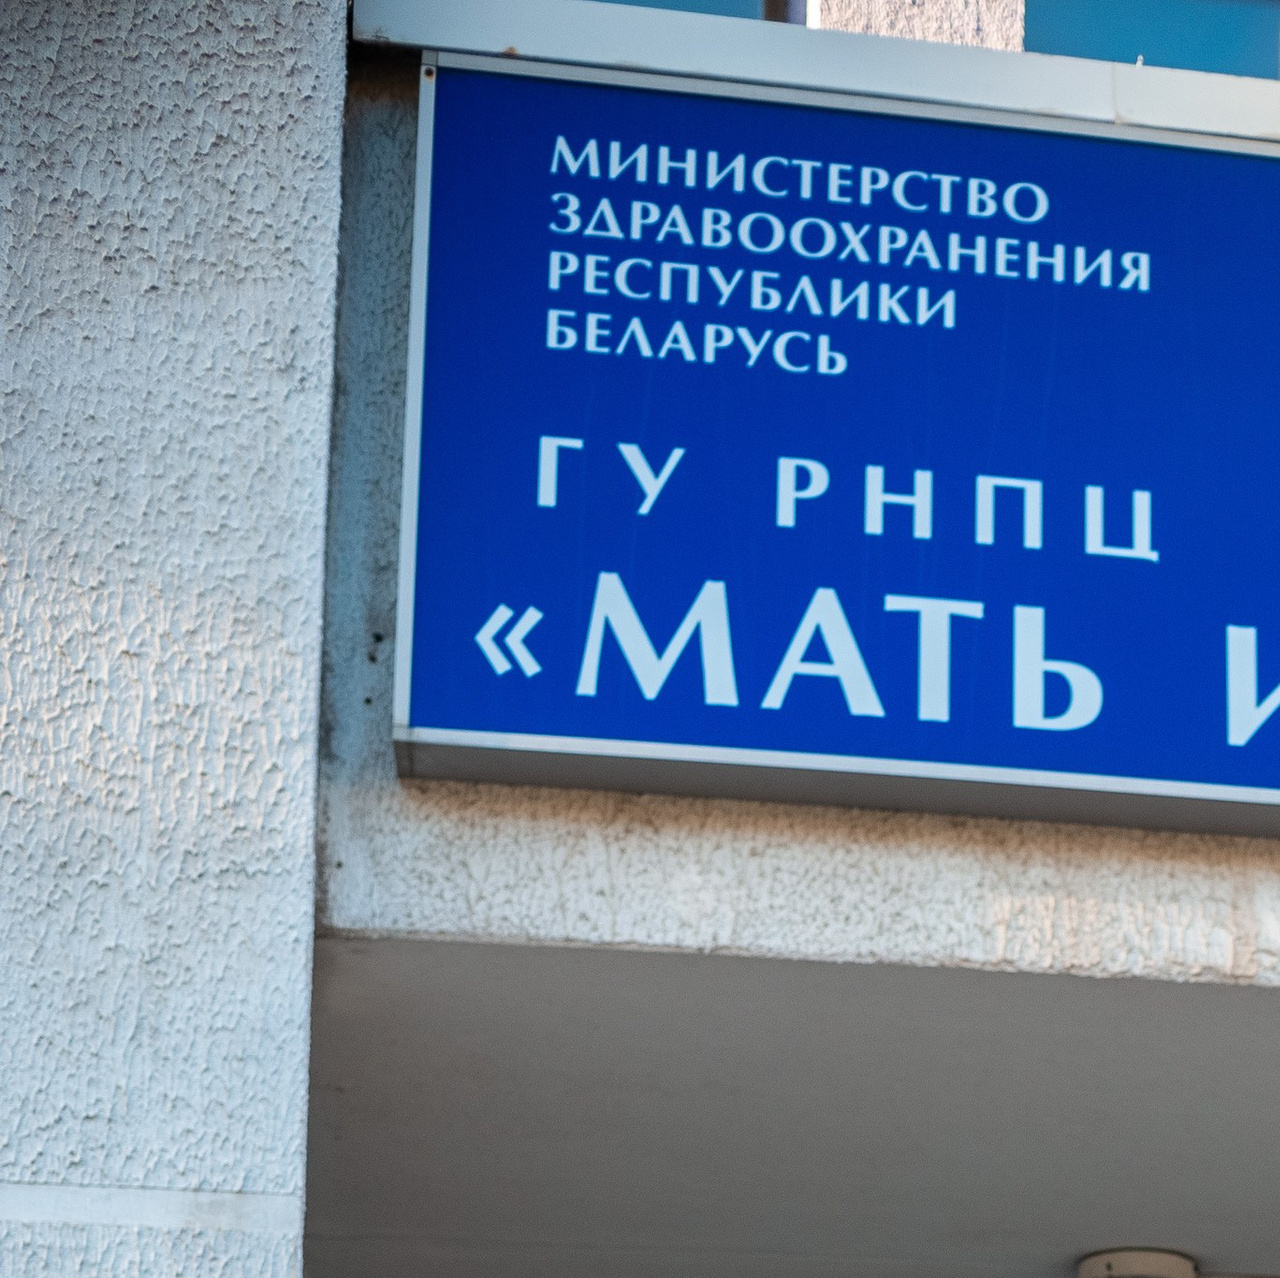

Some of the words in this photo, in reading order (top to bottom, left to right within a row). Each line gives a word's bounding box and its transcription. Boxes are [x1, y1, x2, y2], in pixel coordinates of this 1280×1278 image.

[550, 135, 1049, 223] МИНИСТЕРСТВО
[549, 192, 1151, 292] ЗДРАВООХРАНЕНИЯ
[548, 251, 957, 329] РЕСПУБЛИКИ
[545, 309, 848, 375] БЕЛАРУСЬ
[536, 435, 685, 515] ГУ
[775, 456, 1160, 562] РНПЦ
[475, 571, 1104, 732] «МАТЬ
